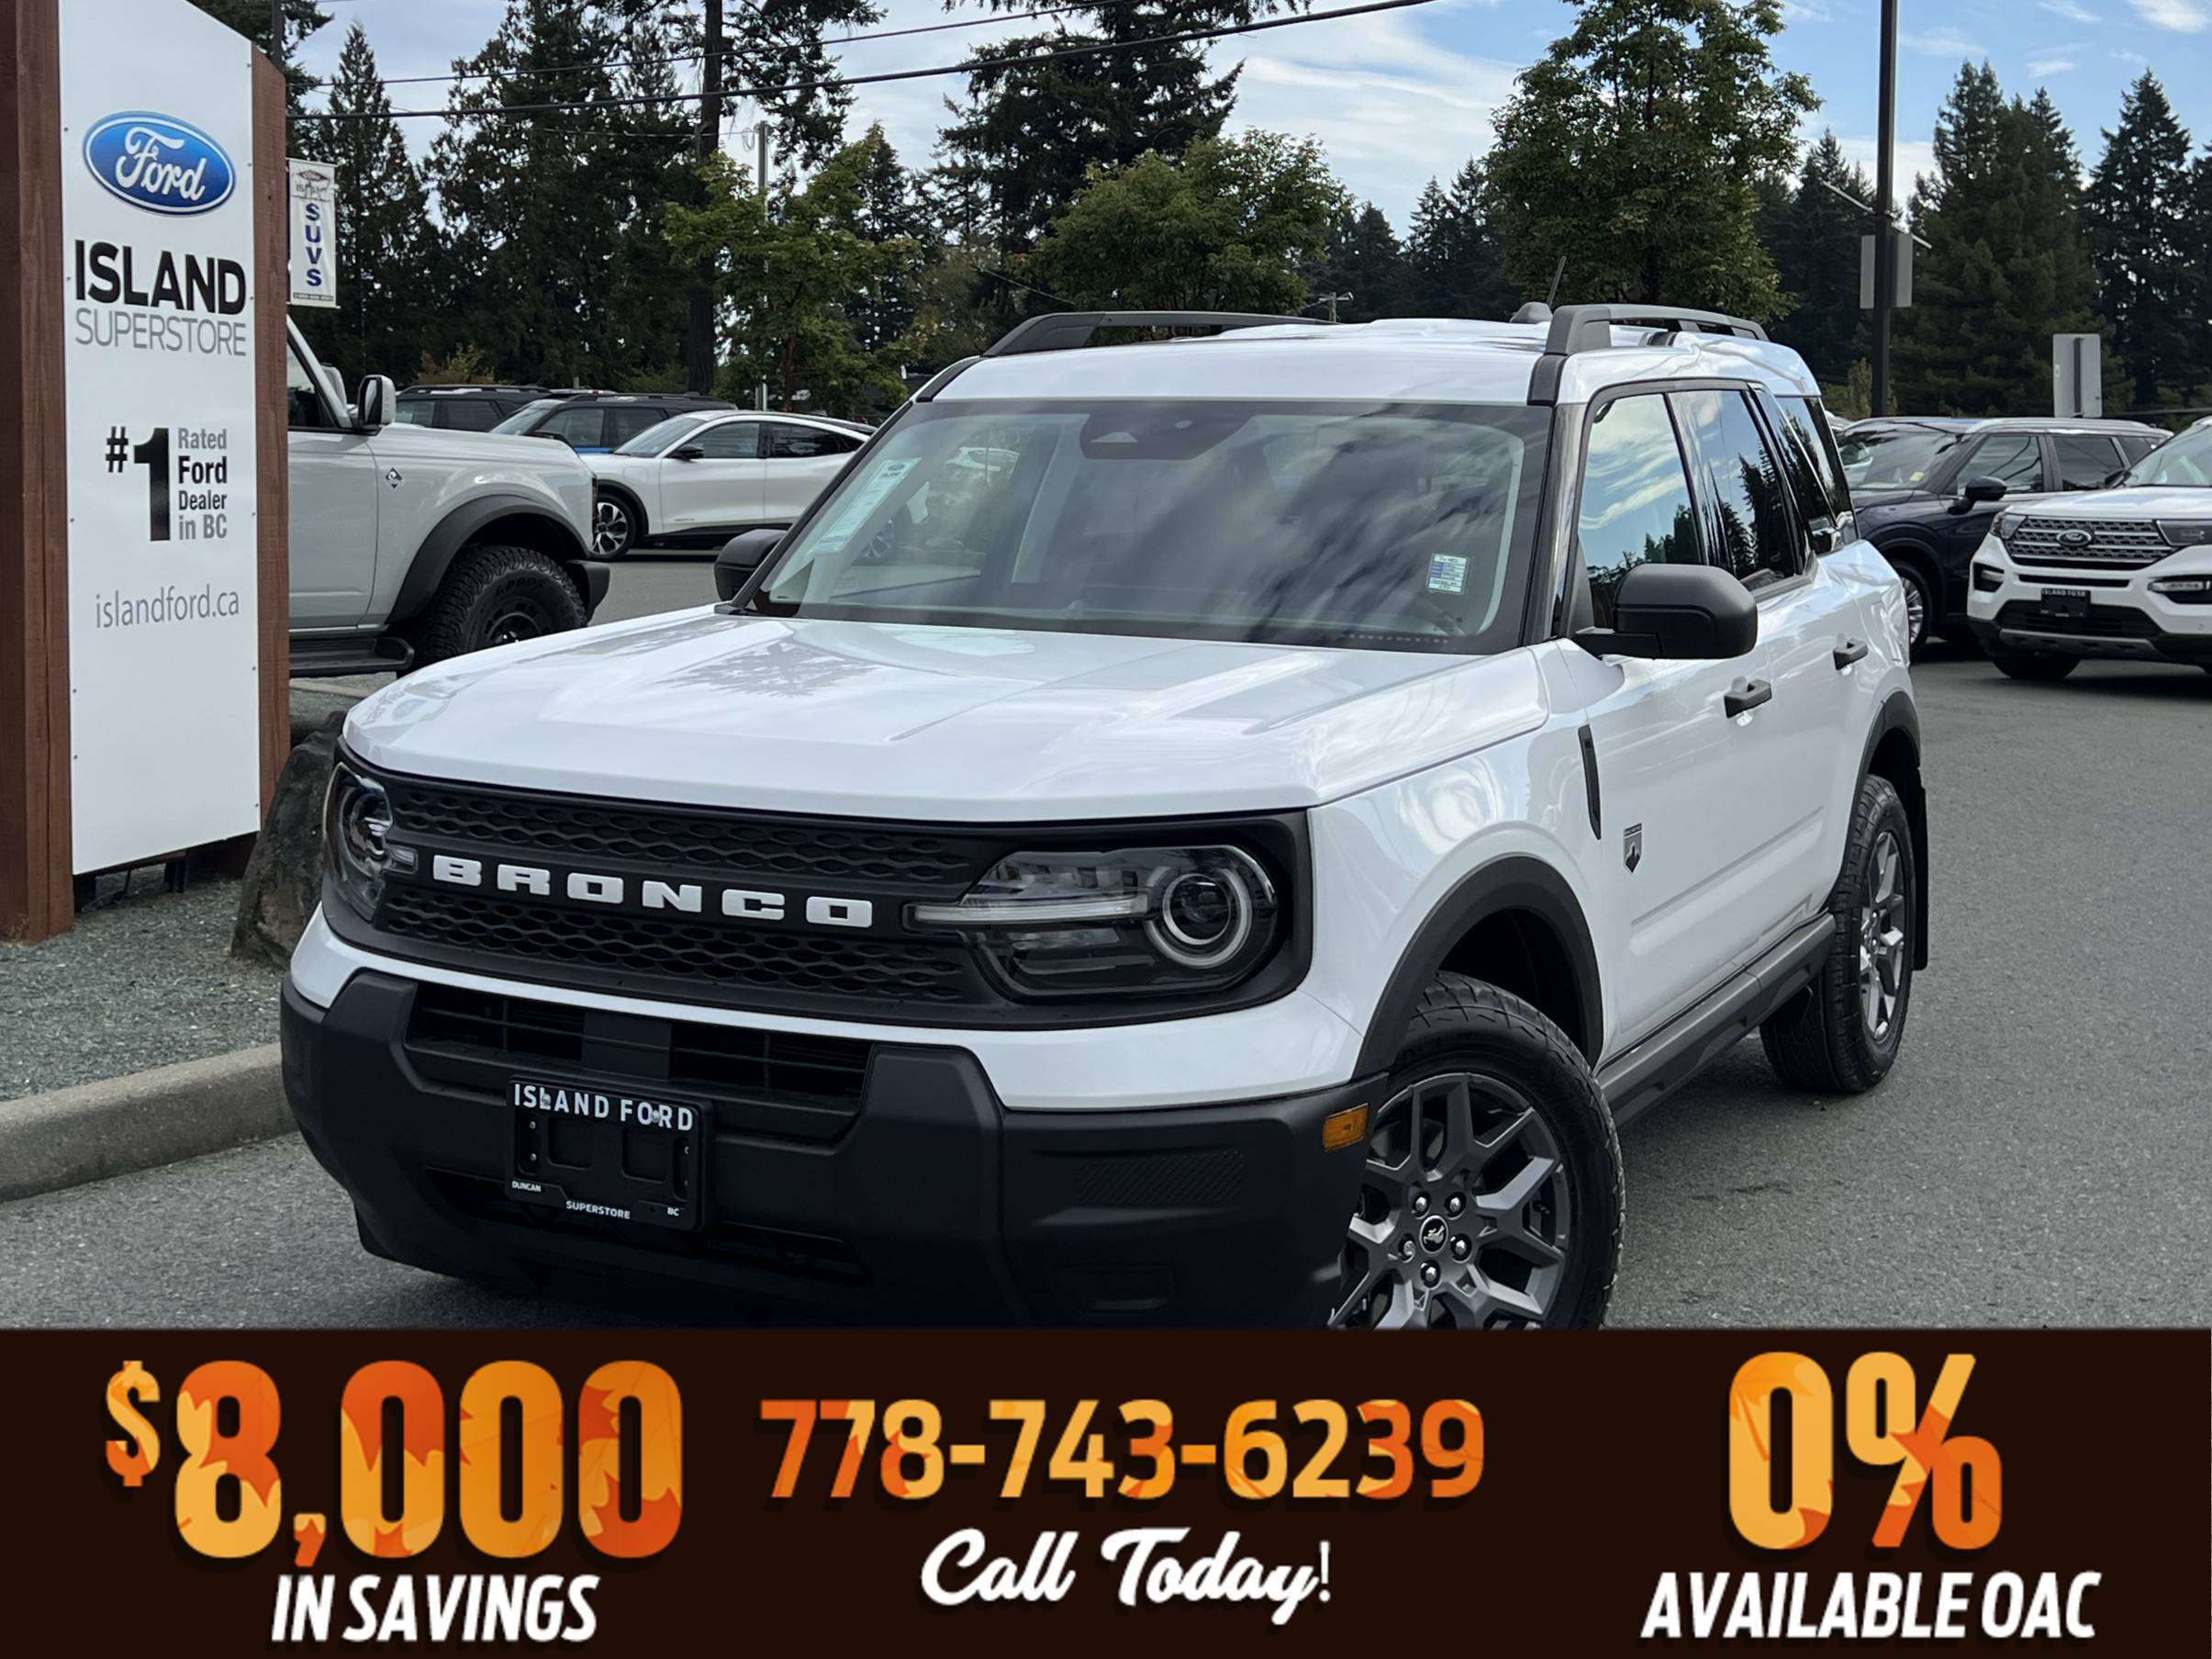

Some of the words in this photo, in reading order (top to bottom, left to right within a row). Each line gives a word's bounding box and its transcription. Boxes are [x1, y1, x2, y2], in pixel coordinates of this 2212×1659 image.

[115, 126, 206, 201] Ford
[74, 239, 246, 315] ISLAND
[75, 307, 246, 356] SUPERSTORE
[178, 428, 228, 450] Rated
[106, 426, 170, 541] #1
[178, 456, 228, 484] Ford
[178, 489, 228, 510] Dealer
[179, 515, 196, 540] in
[203, 513, 228, 539] BC
[95, 584, 239, 628] islandford.ca
[432, 854, 873, 927] BRONCO
[514, 1083, 609, 1118] ISLAND
[620, 1098, 693, 1131] FORD
[511, 1181, 542, 1193] DUNCAN
[565, 1200, 631, 1219] SUPERSTORE
[666, 1206, 680, 1216] BC
